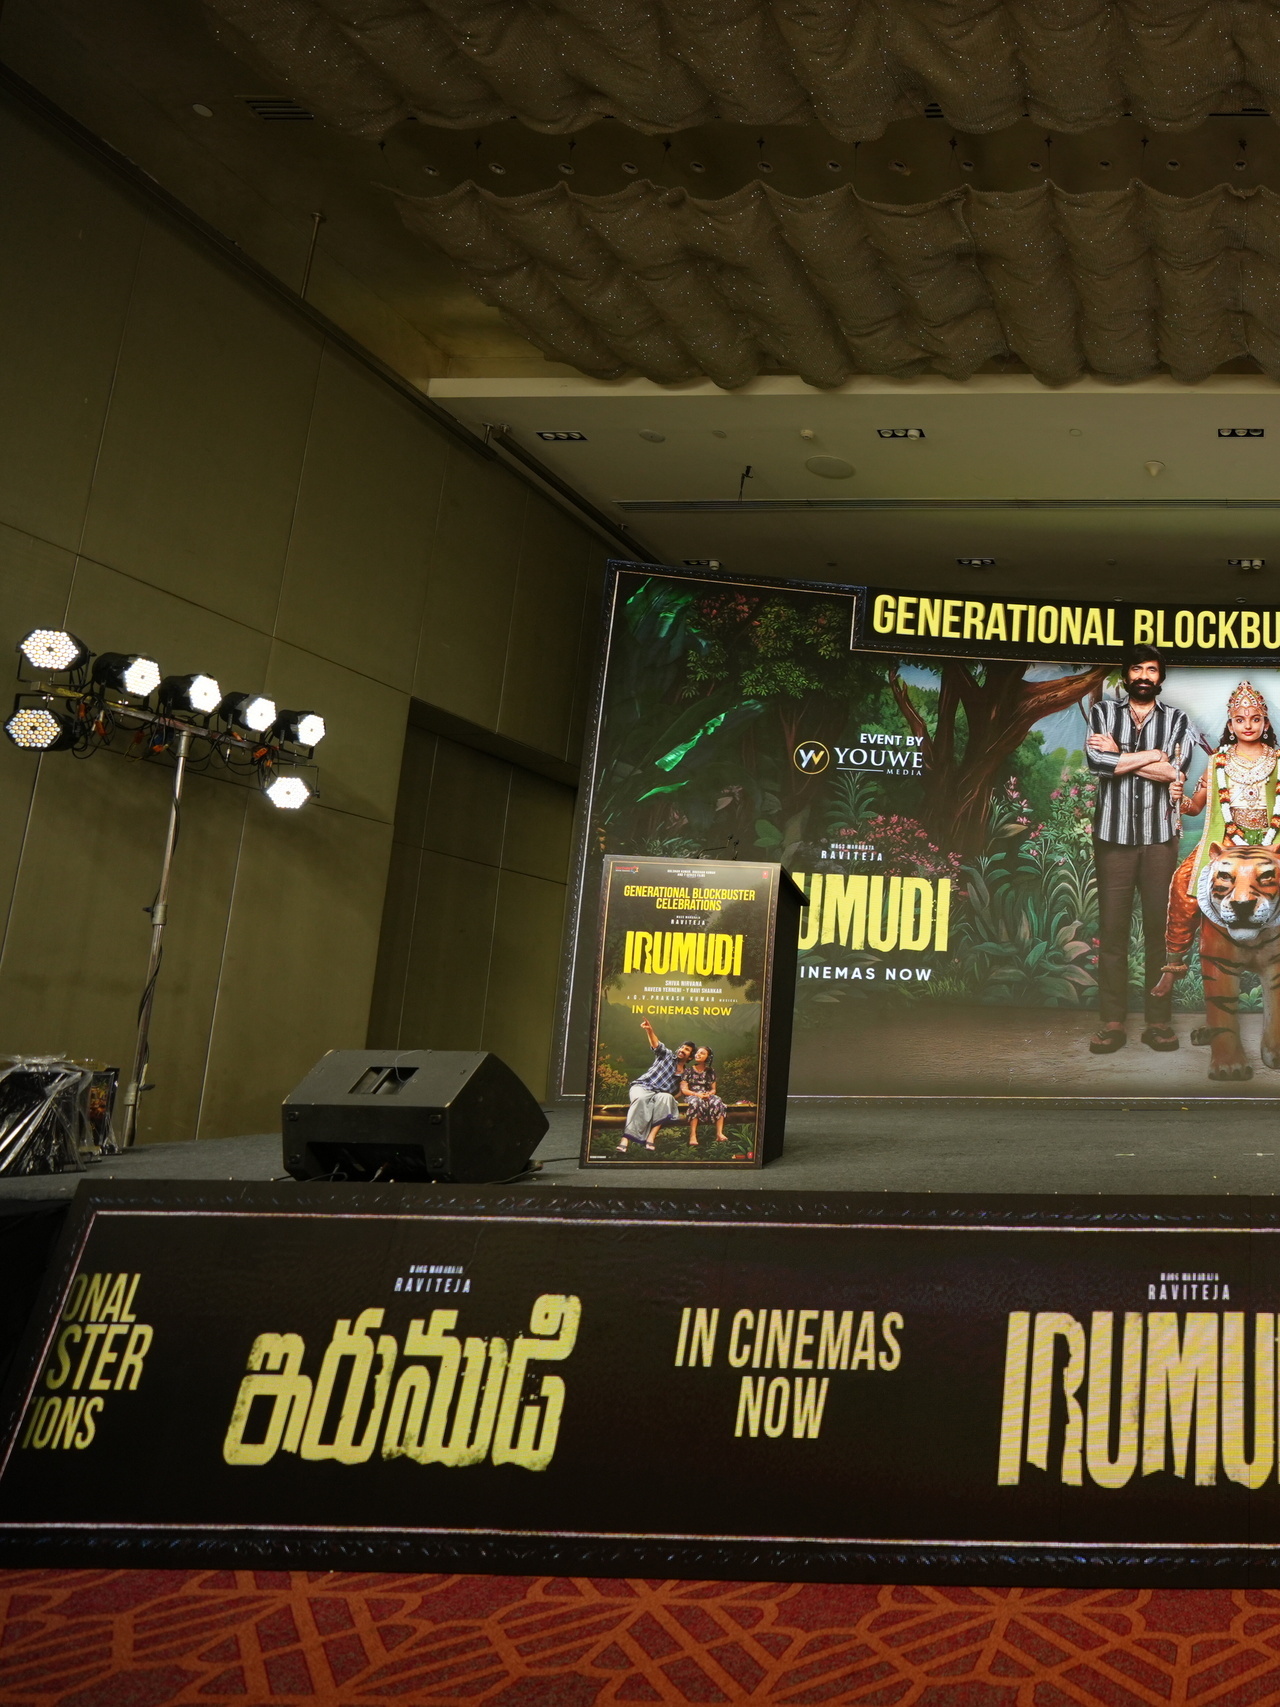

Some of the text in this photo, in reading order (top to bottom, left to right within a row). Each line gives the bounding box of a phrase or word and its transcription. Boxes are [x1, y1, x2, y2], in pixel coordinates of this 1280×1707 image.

[873, 594, 1124, 647] GENERATIONAL
[860, 733, 923, 747] EVENT BY
[834, 747, 923, 769] YOUWE
[886, 768, 922, 776] MEDIA
[821, 850, 883, 861] RAVITEJA
[624, 885, 755, 901] GENERATIONAL BLOCKBUSTER
[656, 898, 722, 911] CELEBRATIONS
[792, 871, 951, 952] UMUDI
[624, 931, 743, 976] IRUMUDI
[800, 966, 932, 981] INEMAS NOW
[632, 1005, 732, 1016] IN CINEMAS NOW
[394, 1277, 471, 1293] RAVITEJA
[1148, 1284, 1230, 1300] RAVITEJA
[675, 1307, 905, 1372] IN CINEMAS
[45, 1324, 154, 1391] STER
[734, 1376, 829, 1439] NOW
[22, 1396, 105, 1449] IONS
